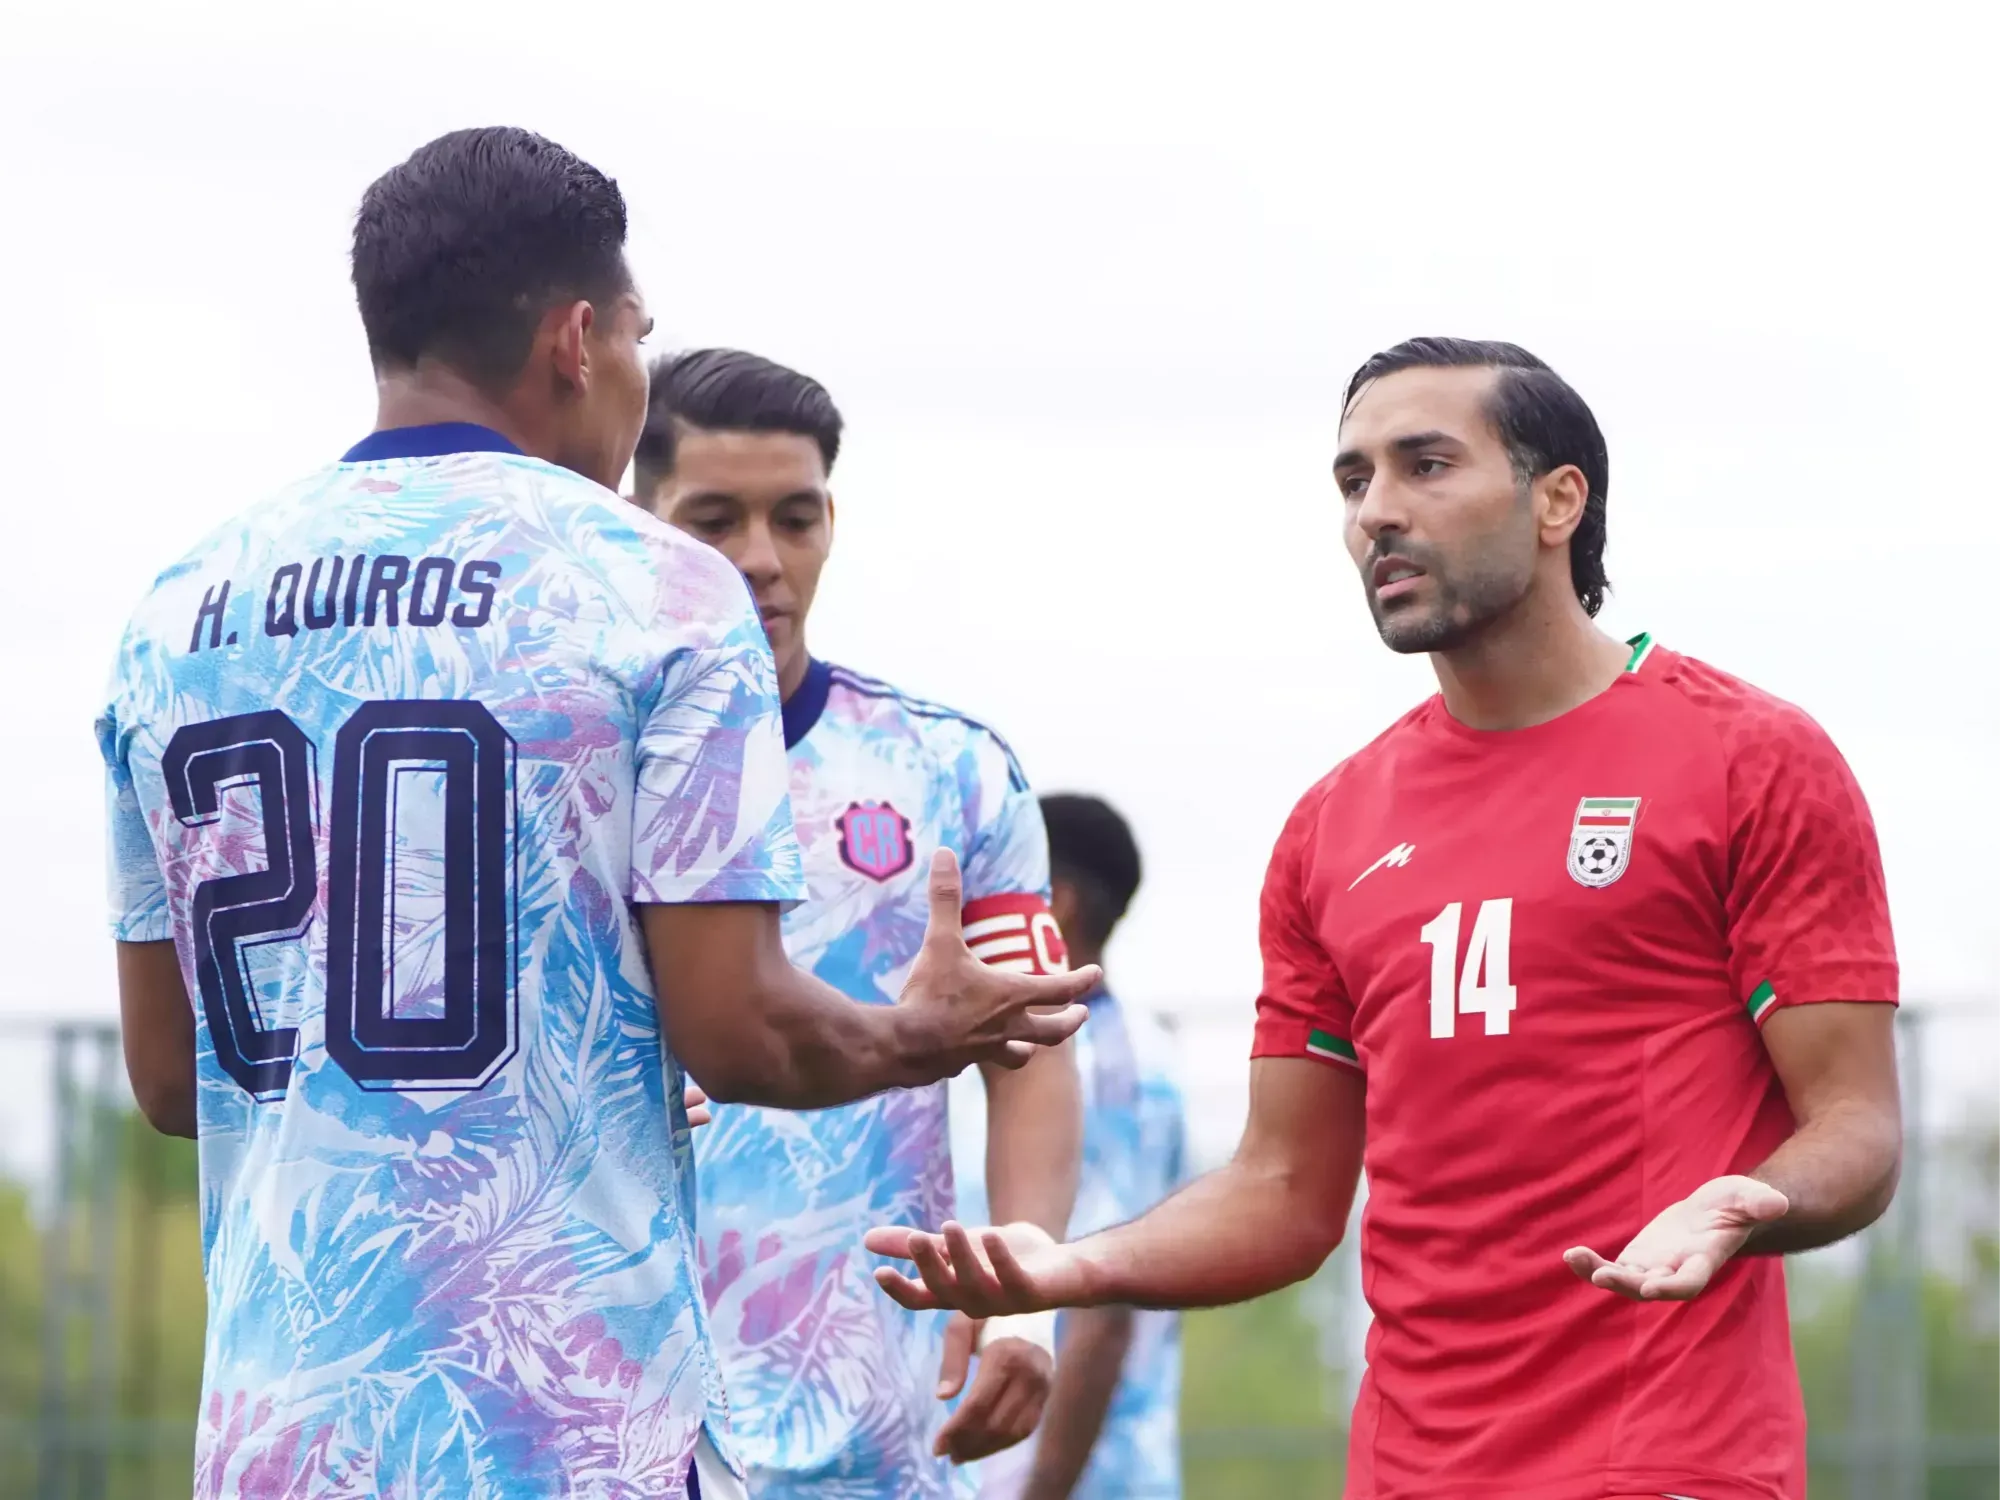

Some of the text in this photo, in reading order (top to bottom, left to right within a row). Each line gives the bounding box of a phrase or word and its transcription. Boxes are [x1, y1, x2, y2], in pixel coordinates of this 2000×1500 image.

[190, 553, 502, 653] H. QUIROS
[852, 814, 898, 867] CR
[161, 699, 520, 1105] 20
[1420, 897, 1517, 1039] 14
